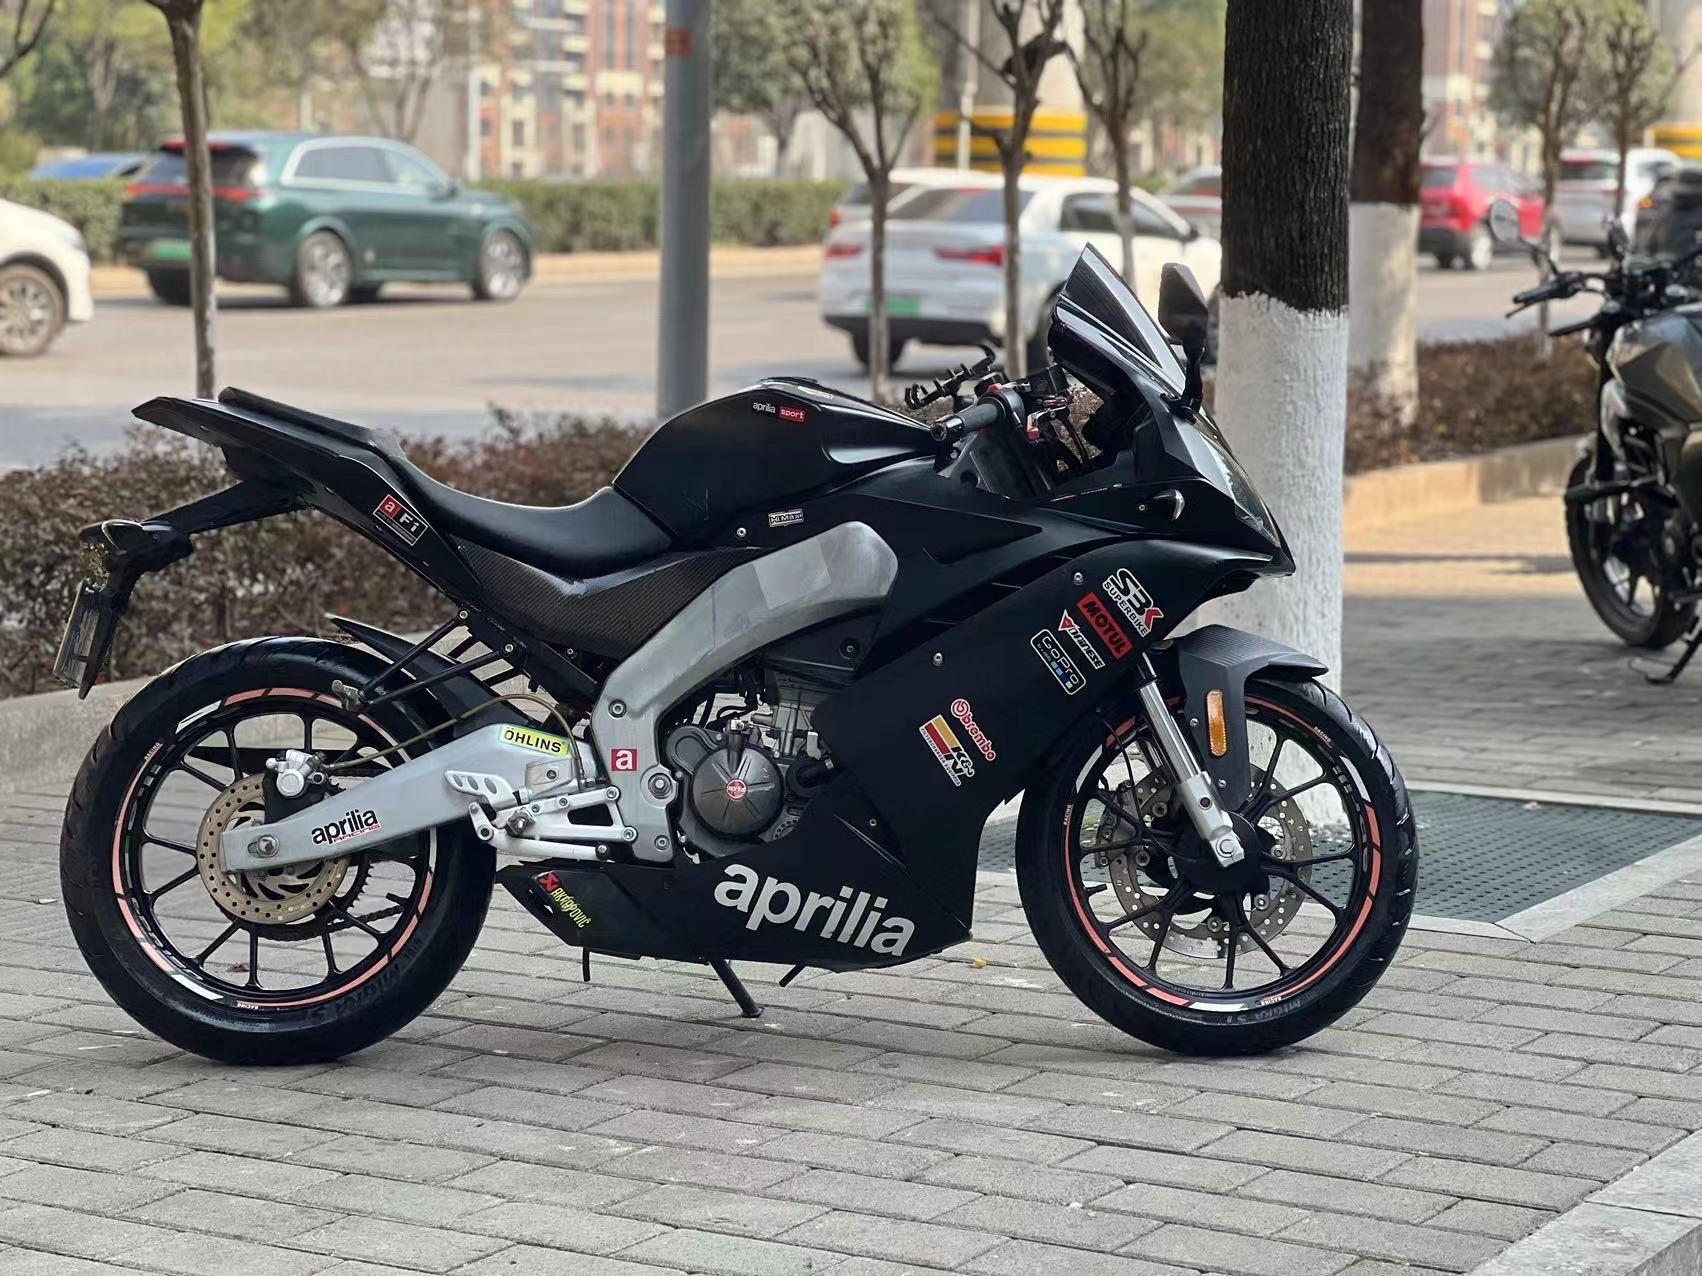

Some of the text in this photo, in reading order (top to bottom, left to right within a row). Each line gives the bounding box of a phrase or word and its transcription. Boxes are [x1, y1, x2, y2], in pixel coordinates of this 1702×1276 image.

[752, 401, 805, 419] aprilia sport
[1102, 580, 1149, 637] SUPERBIKE
[1108, 568, 1164, 632] SBK
[1083, 600, 1128, 654] MOTUL
[1041, 636, 1080, 685] GoPro
[504, 727, 562, 753] ÖHLINS
[615, 749, 633, 770] a
[311, 808, 379, 845] aprilia
[713, 863, 916, 957] aprilia
